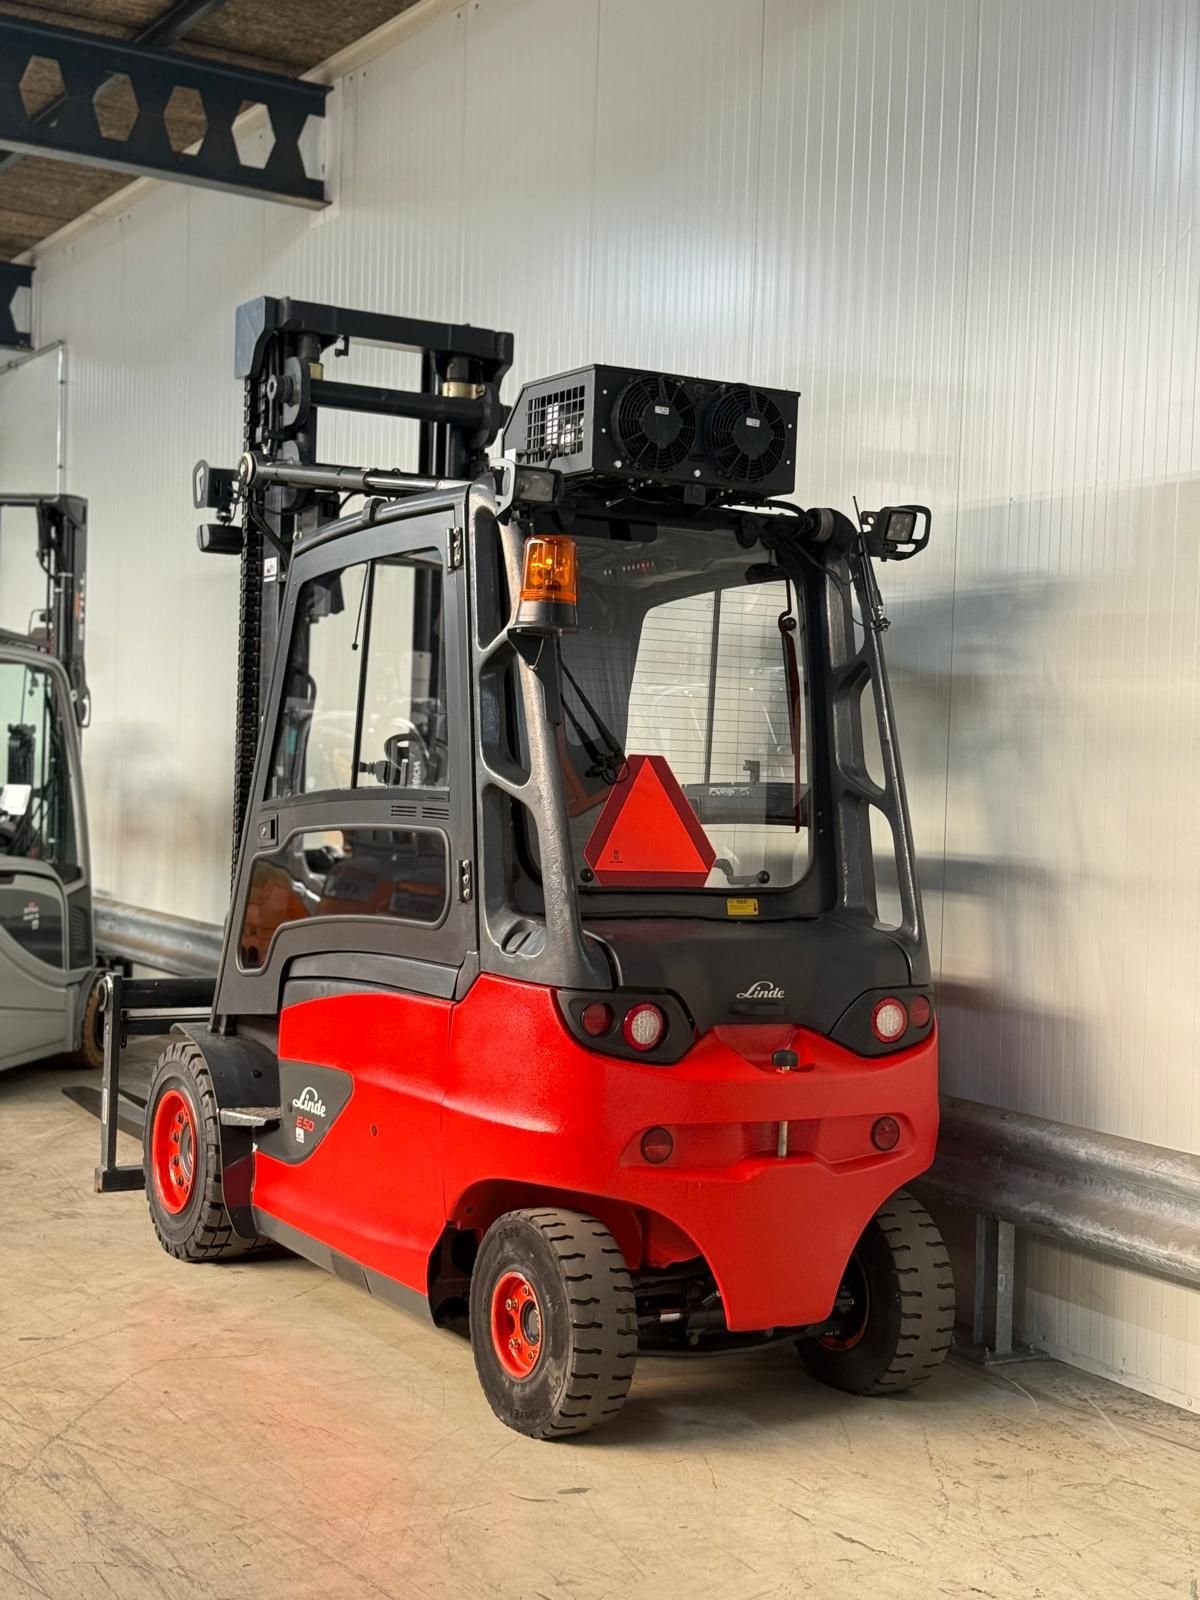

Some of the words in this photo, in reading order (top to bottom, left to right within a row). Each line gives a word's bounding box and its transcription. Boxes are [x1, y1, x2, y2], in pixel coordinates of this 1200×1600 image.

[736, 980, 785, 999] Linde
[292, 1086, 327, 1118] Linde
[296, 1115, 315, 1132] E50
